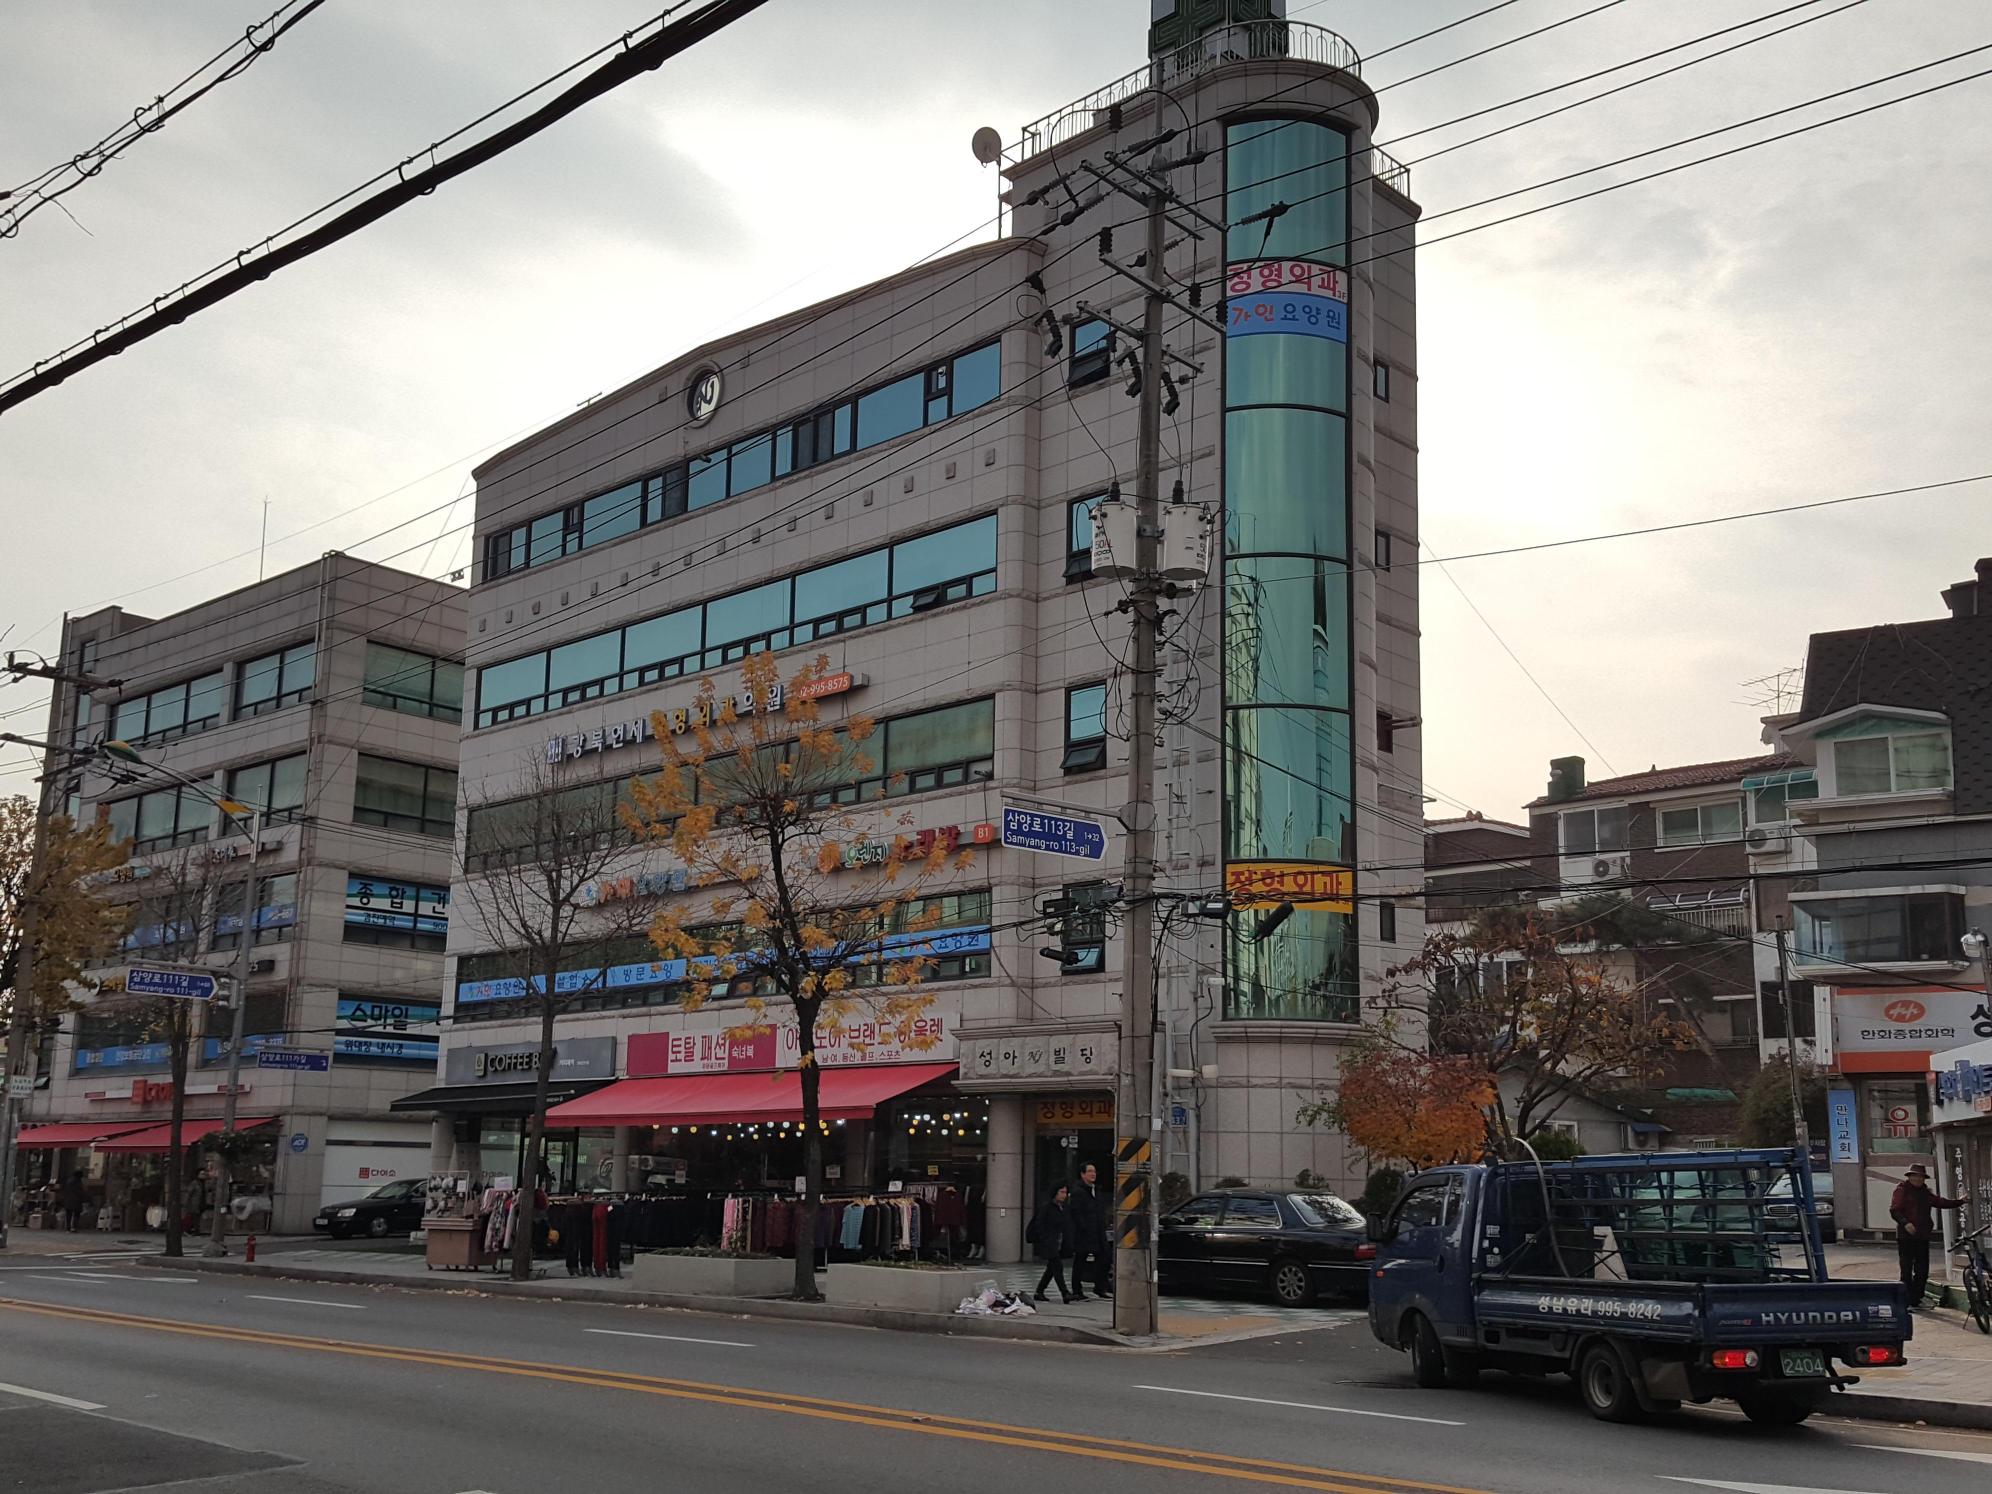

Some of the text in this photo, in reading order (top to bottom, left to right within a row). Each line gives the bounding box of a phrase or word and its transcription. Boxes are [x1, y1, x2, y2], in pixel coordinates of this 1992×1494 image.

[1229, 262, 1337, 297] 정형외과
[1007, 812, 1074, 840] 삼양로113길
[980, 830, 990, 844] B1
[1006, 831, 1090, 856] Samyang-ro 113-gil
[131, 971, 189, 987] 삼양로111길
[350, 1004, 409, 1032] 스마일
[1860, 1027, 1955, 1041] 한화종합화학
[670, 1033, 727, 1063] 토탈 패션
[731, 1044, 755, 1060] 숙녀복
[488, 1052, 530, 1073] COFFEE
[1834, 1103, 1851, 1153] 만나교회
[1598, 1300, 1662, 1321] 995-8242
[1761, 1310, 1862, 1326] HYUNDAI
[1783, 1357, 1825, 1376] 2404
